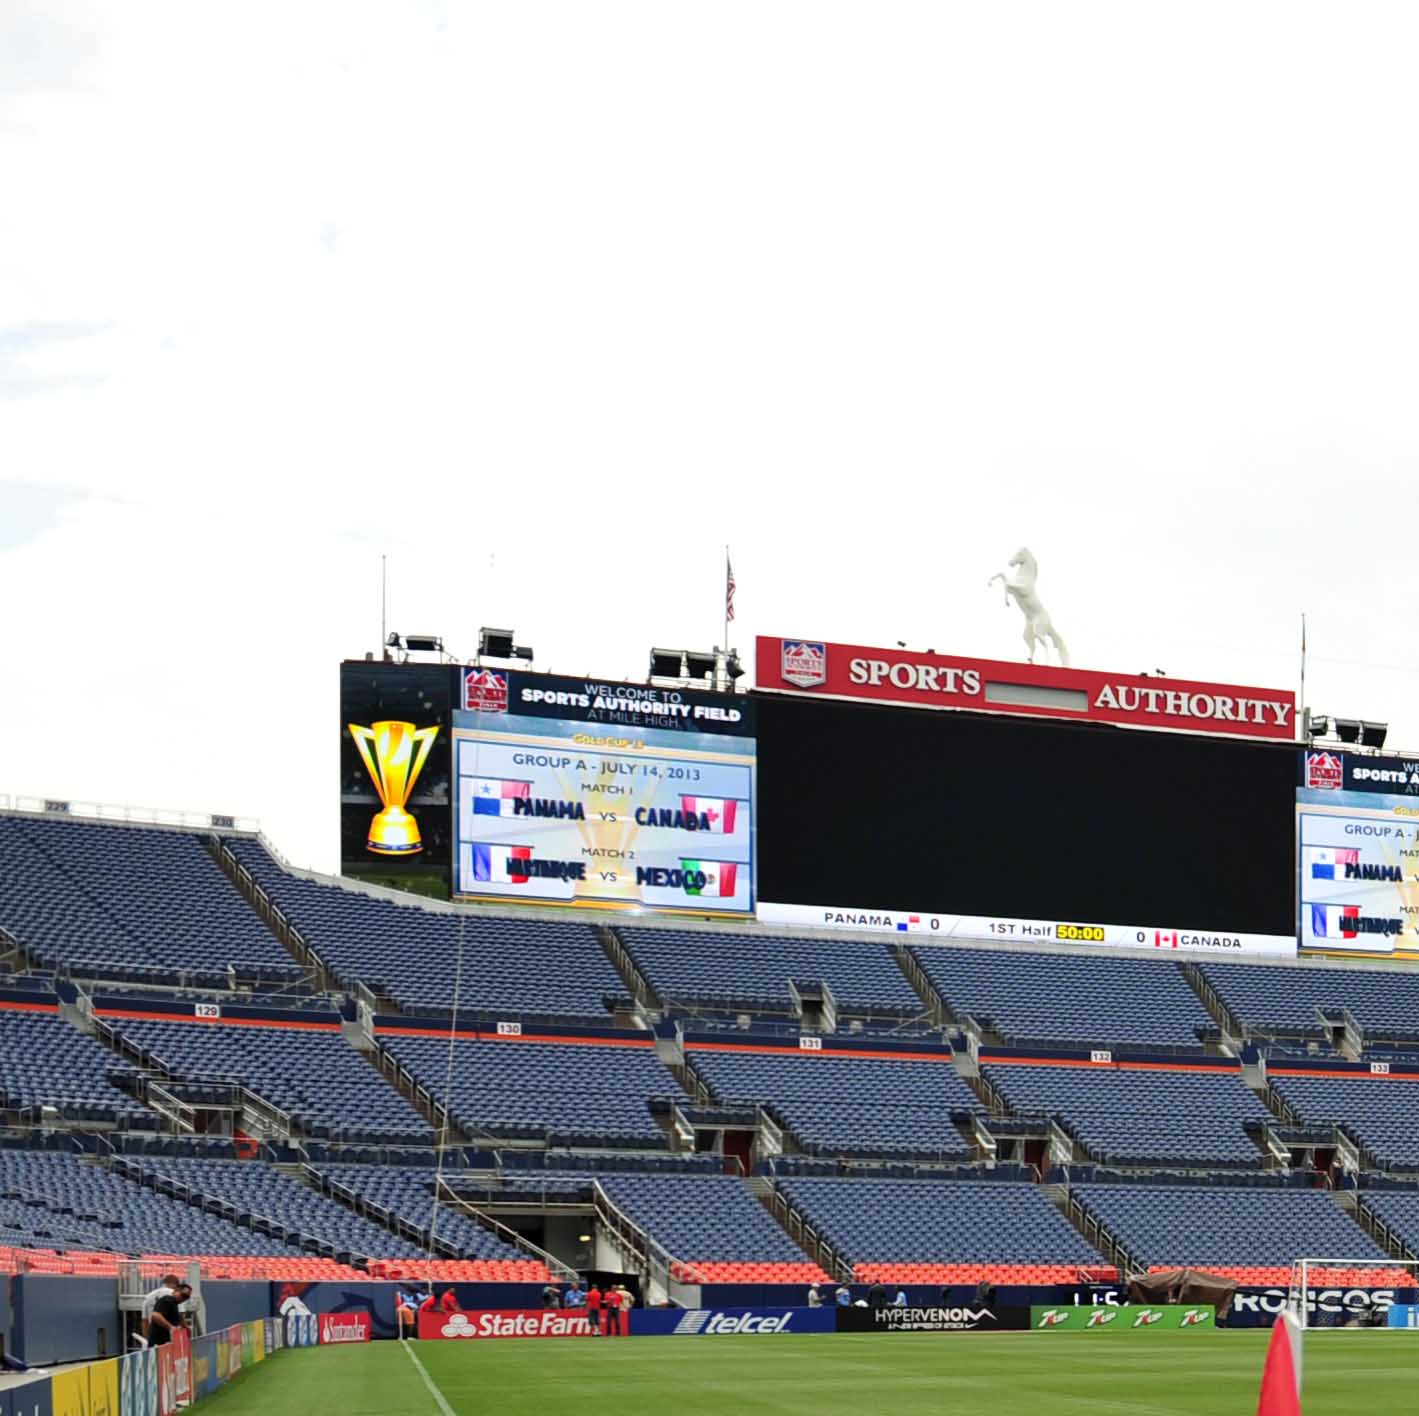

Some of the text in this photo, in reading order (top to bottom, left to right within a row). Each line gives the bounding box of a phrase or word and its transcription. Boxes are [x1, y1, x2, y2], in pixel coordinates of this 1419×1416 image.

[849, 658, 981, 695] SPORTS
[584, 683, 683, 704] WELCOME TO
[521, 687, 590, 708] SPORTS
[593, 696, 692, 718] AUTHORITY
[694, 706, 743, 723] FIELD
[1093, 683, 1292, 726] AUTHORITY
[588, 709, 606, 722] AT
[608, 712, 642, 726] MILE
[513, 752, 571, 769] GROUP
[575, 758, 588, 770] A
[600, 760, 637, 776] JULY
[667, 767, 701, 781] 2013
[1352, 767, 1408, 784] SPORTS
[580, 783, 625, 796] MATCH
[512, 796, 712, 831] PANAMA VS CANADA
[1344, 823, 1391, 838] GROUP
[1394, 828, 1405, 839] A
[581, 848, 625, 860] MATCH
[600, 871, 618, 883] VS
[636, 866, 707, 890] MEXICO
[1344, 862, 1404, 883] PANAMA
[824, 912, 1242, 949] PANAMA 0 1ST Half 50:00 0 CANADA
[196, 1003, 219, 1016] 129
[499, 1023, 521, 1035] 130
[801, 1038, 821, 1048] 131
[1092, 1053, 1111, 1063] 132
[1371, 1063, 1389, 1074] 133
[1234, 1289, 1395, 1313] RONCOS
[705, 1311, 794, 1334] telcel
[875, 1308, 999, 1323] HYPERVENOM
